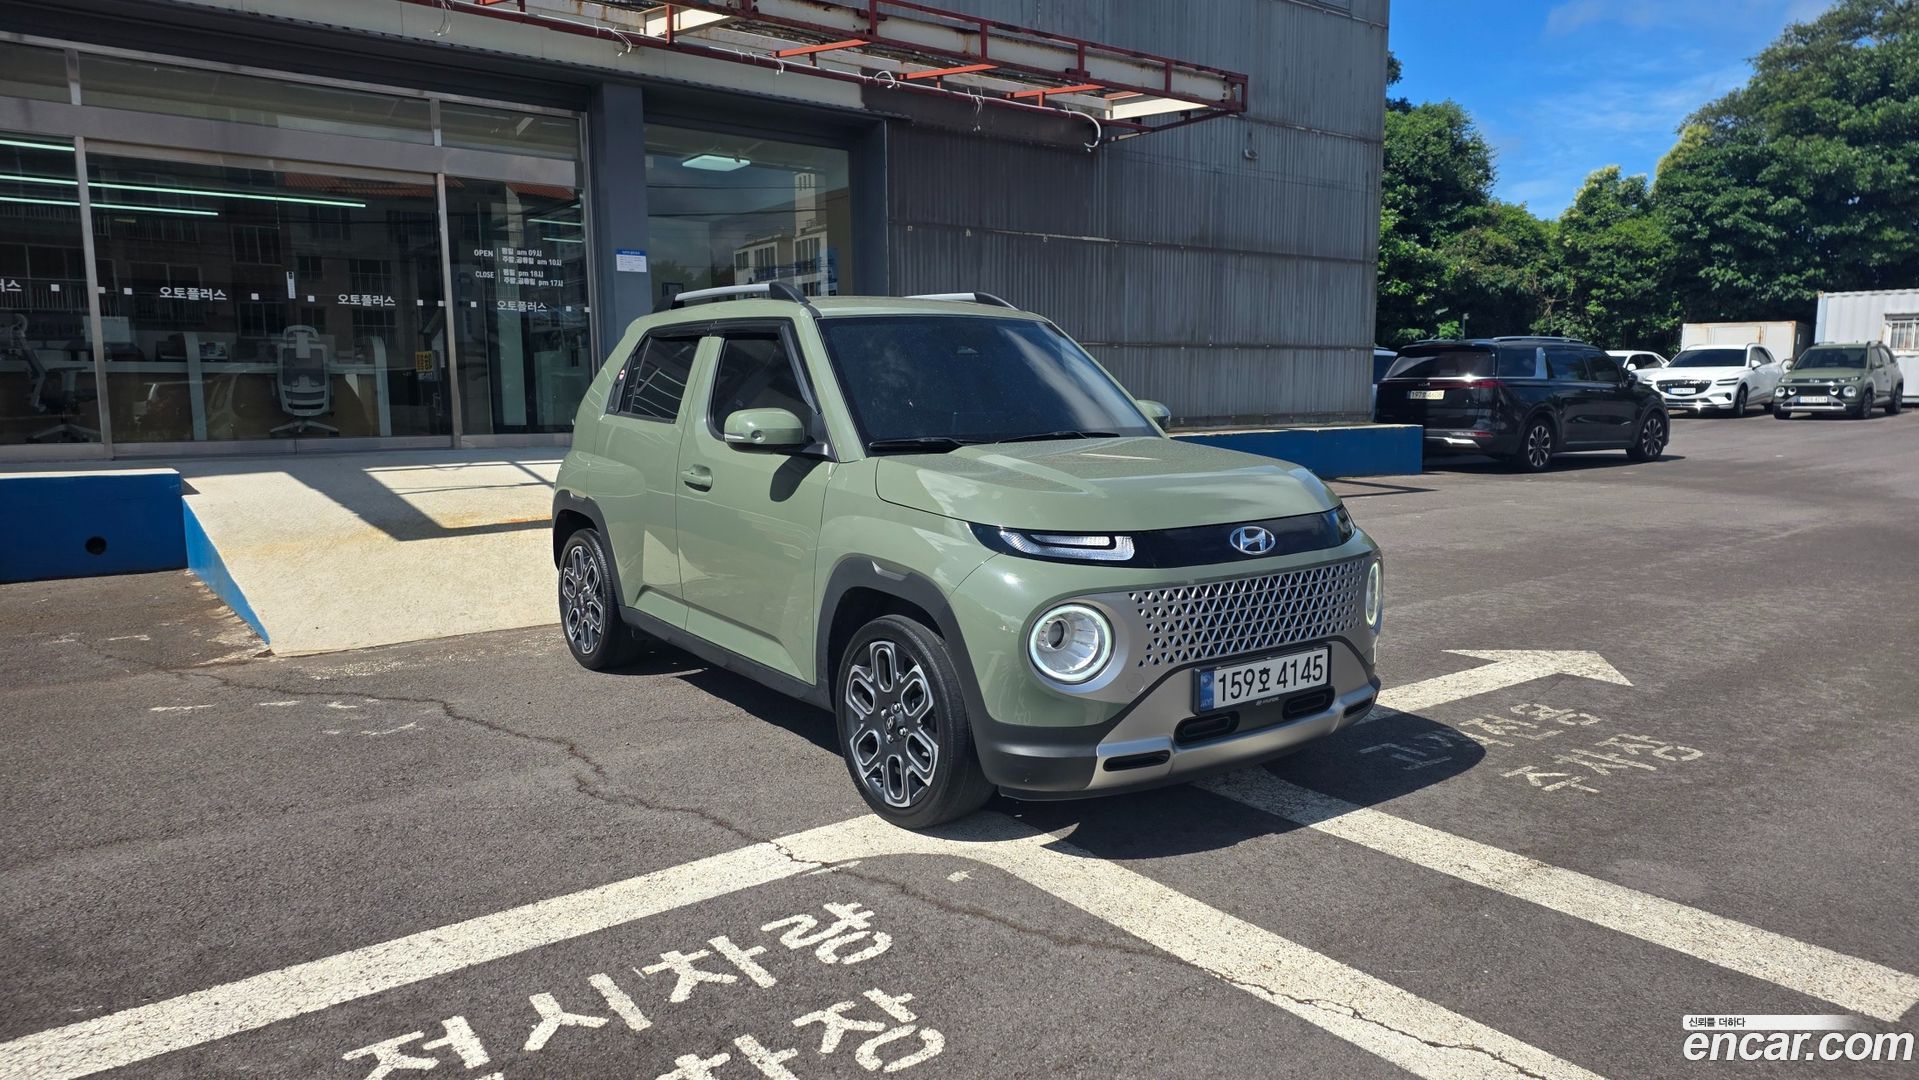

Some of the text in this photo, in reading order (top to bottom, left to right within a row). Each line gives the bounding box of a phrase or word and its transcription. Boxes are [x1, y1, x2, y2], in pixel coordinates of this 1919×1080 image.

[474, 249, 494, 257] OPEN
[528, 249, 542, 257] 09시
[530, 270, 544, 278] 18시
[550, 279, 564, 287] 17시
[159, 286, 228, 301] 오토플러스
[337, 293, 396, 308] 오토플러스
[497, 301, 547, 313] 오토플러스
[1218, 654, 1324, 702] 159호 4145
[1500, 733, 1704, 794] 주차장
